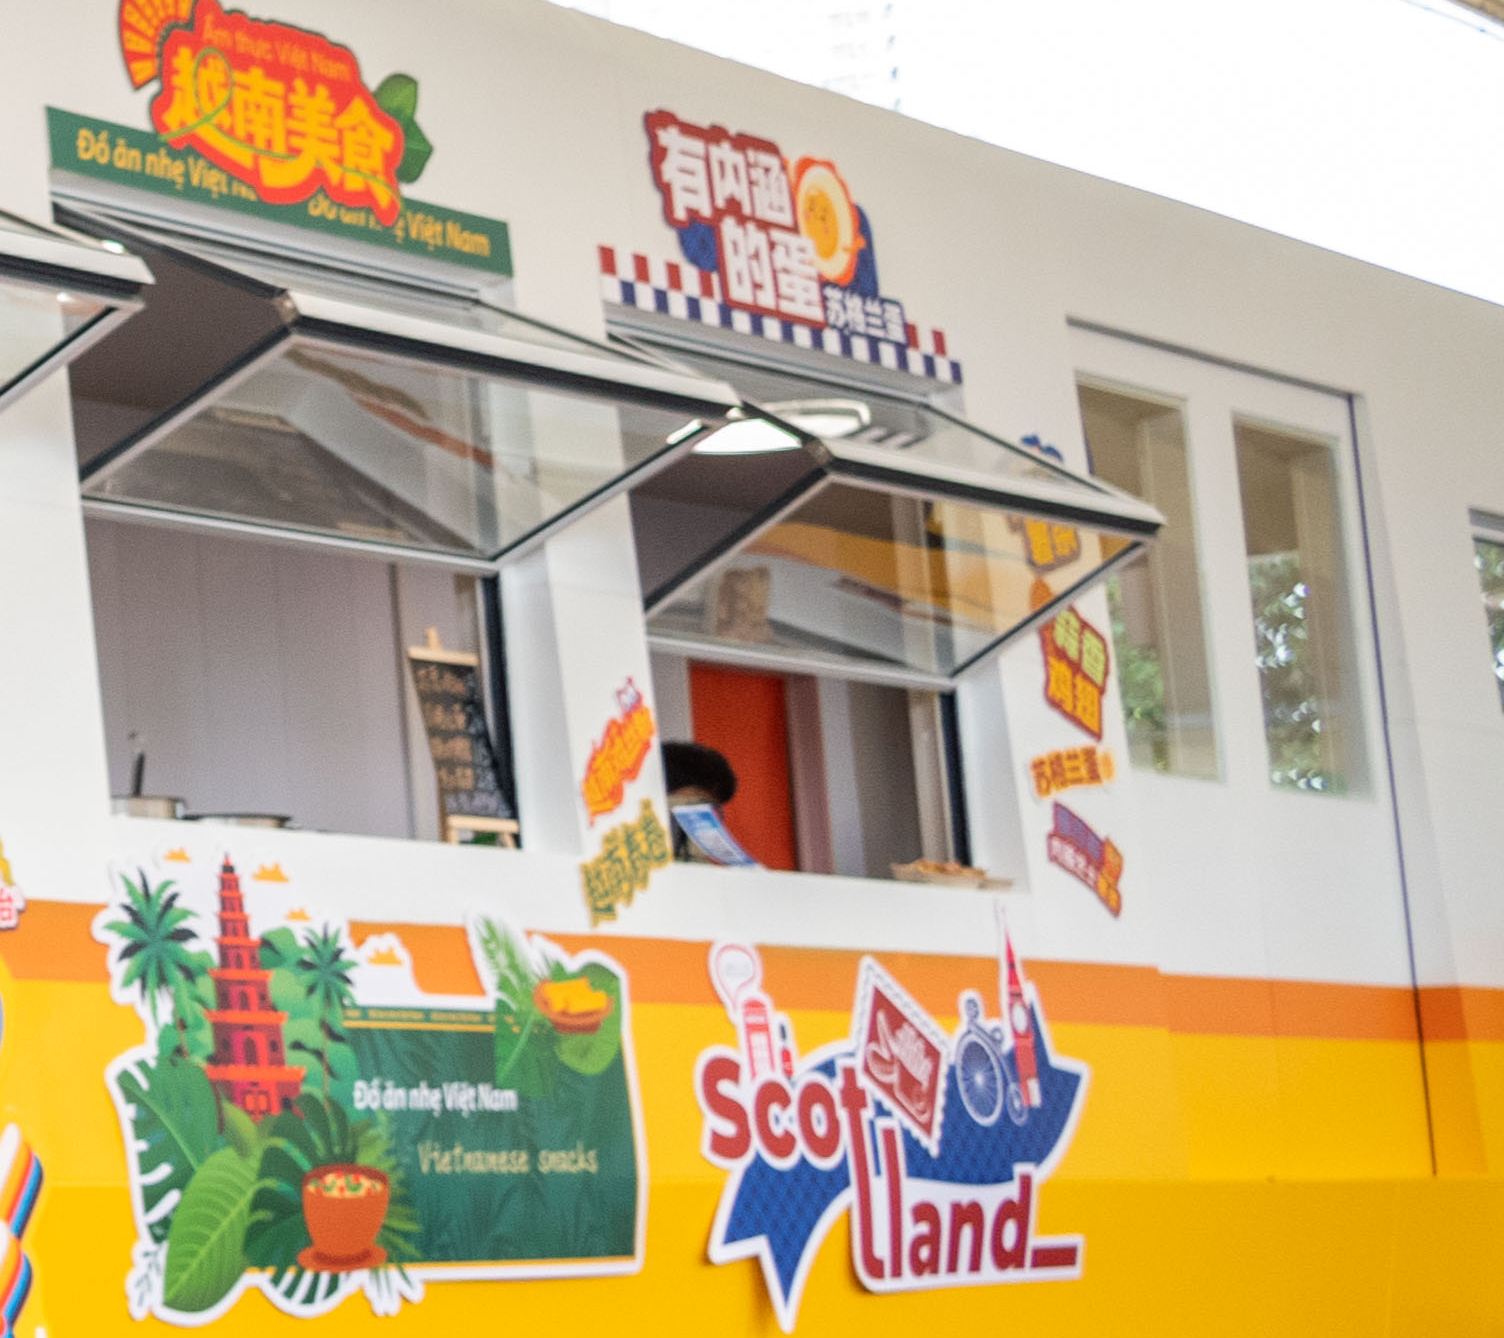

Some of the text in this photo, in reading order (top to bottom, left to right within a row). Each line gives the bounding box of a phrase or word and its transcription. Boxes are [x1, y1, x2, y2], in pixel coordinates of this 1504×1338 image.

[162, 45, 402, 211] 越南美食
[446, 219, 491, 258] Nam
[719, 215, 825, 323] 的蛋
[822, 283, 908, 345] 苏格兰蛋
[477, 1082, 518, 1111] Nam
[417, 1140, 531, 1175] Vietnamese
